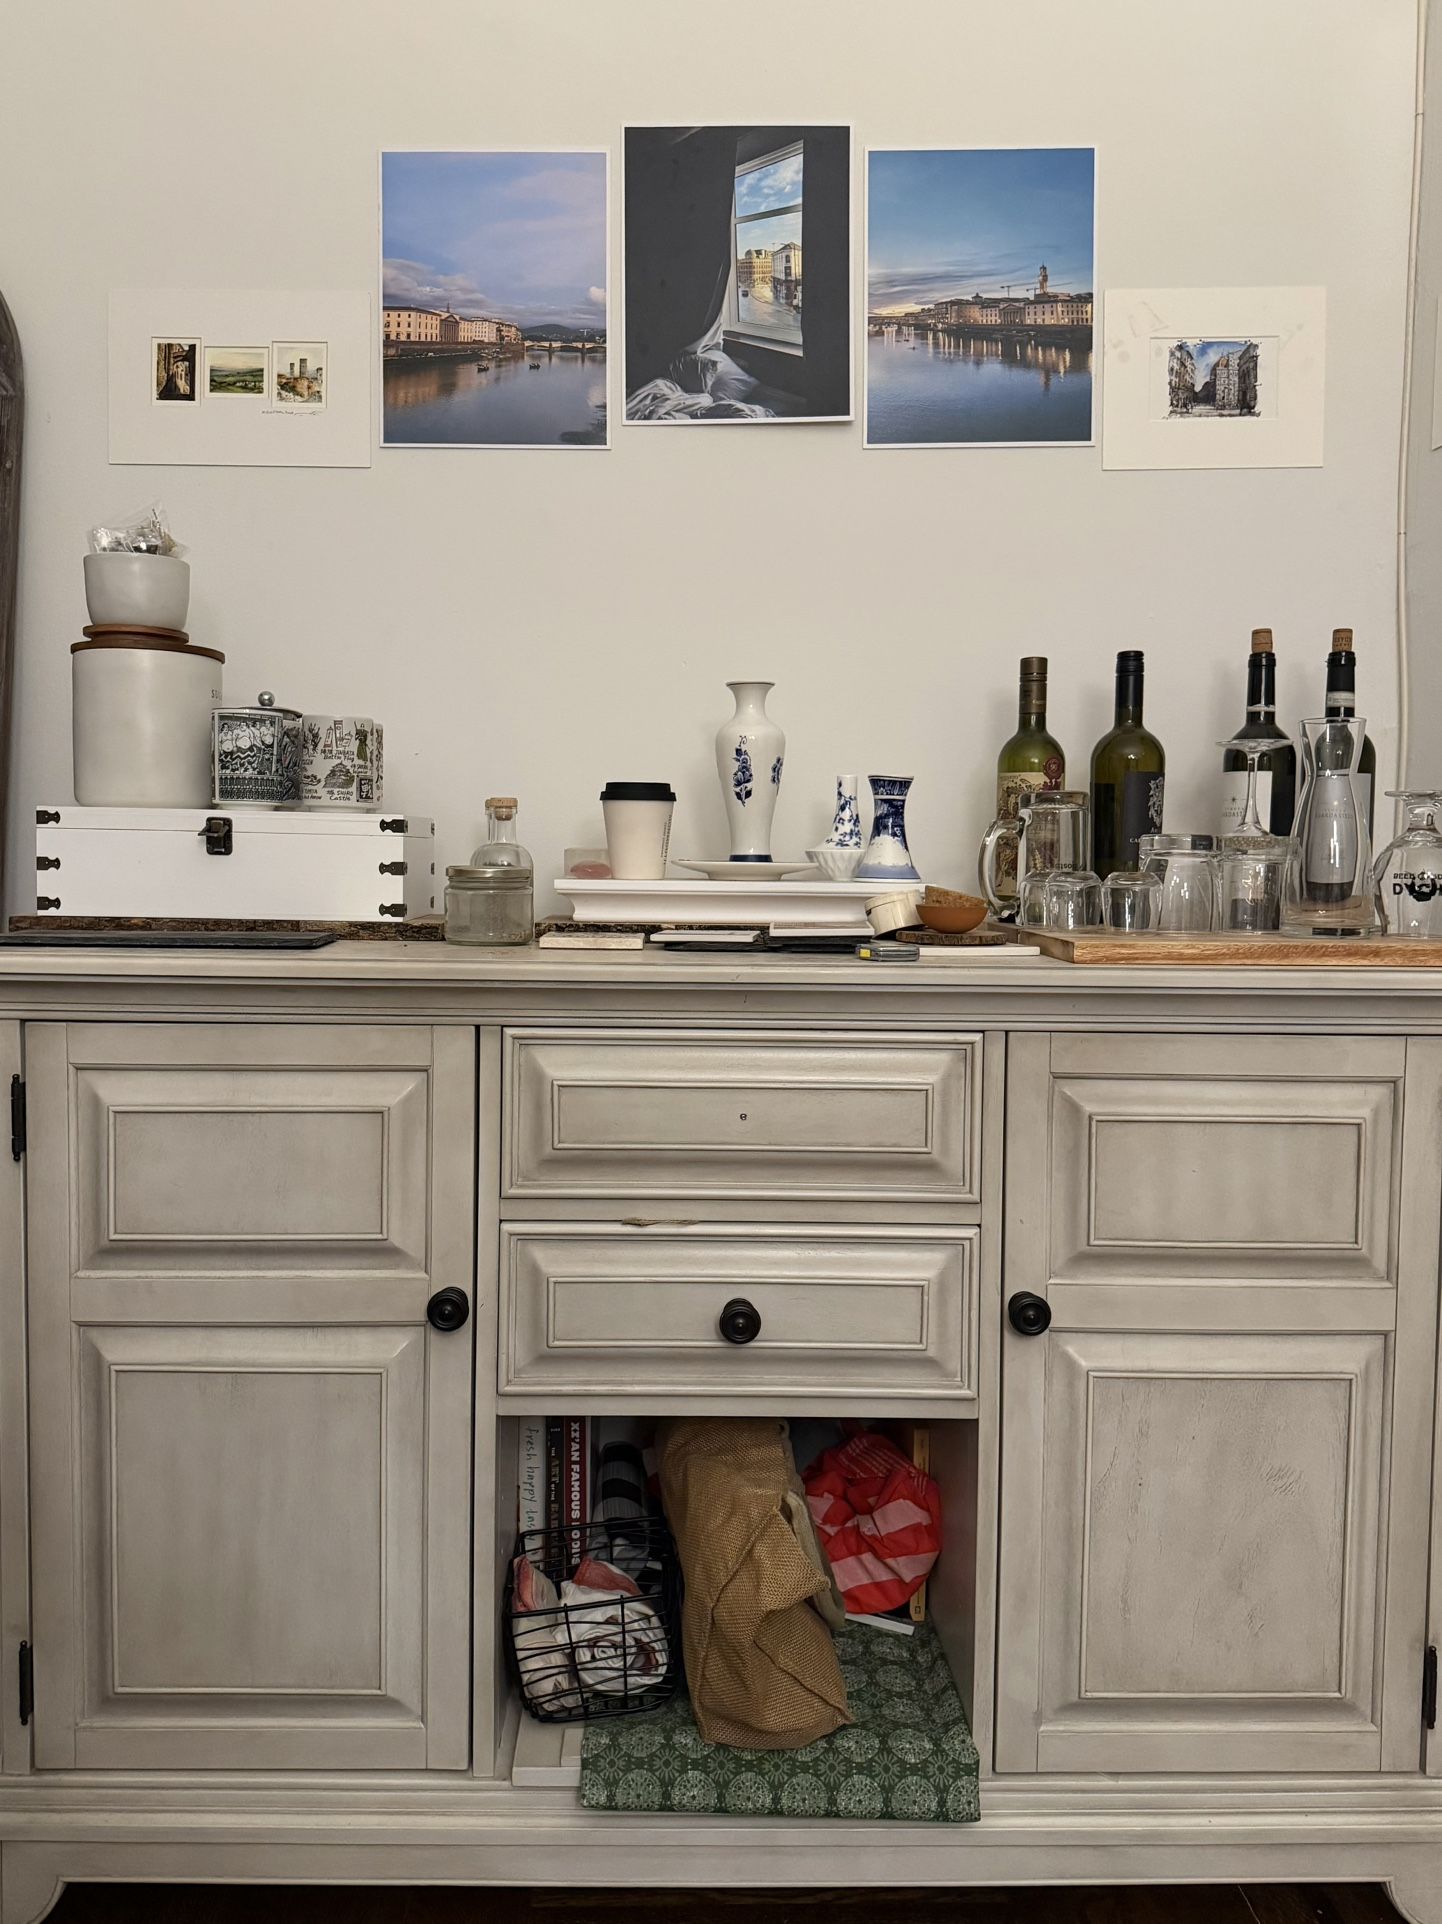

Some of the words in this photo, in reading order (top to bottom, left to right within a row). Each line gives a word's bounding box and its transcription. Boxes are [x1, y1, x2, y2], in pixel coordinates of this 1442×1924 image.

[522, 1466, 542, 1503] happy
[551, 1458, 560, 1484] ART
[571, 1464, 581, 1519] FAMOUS
